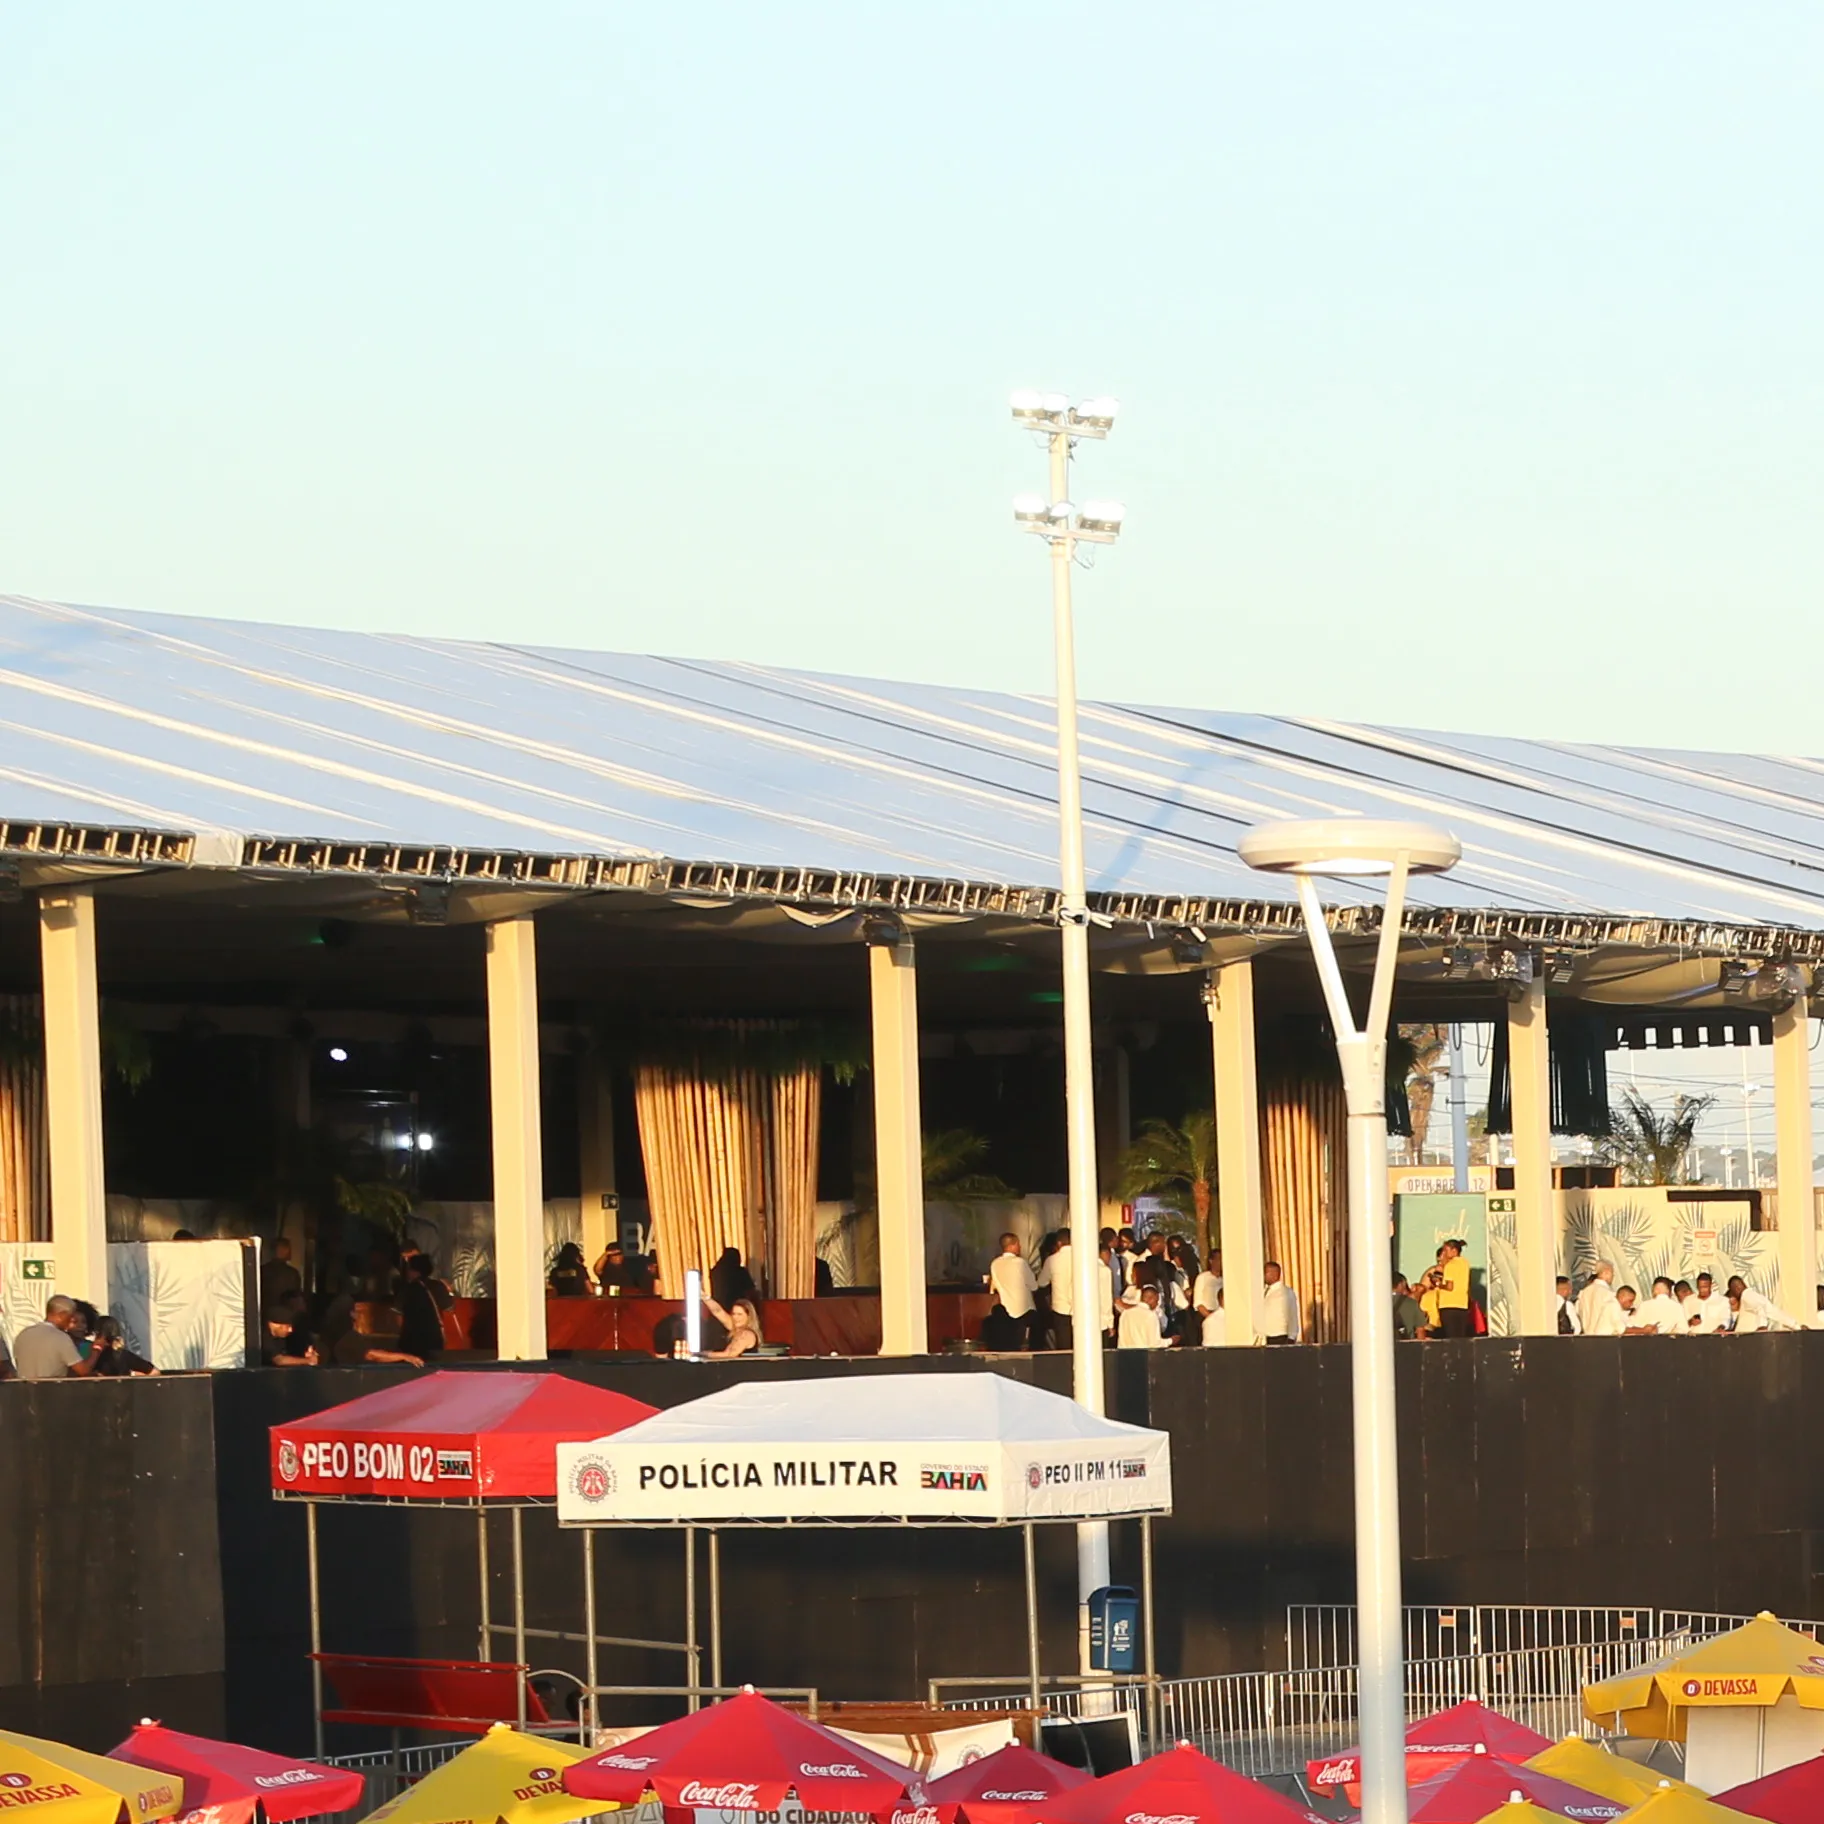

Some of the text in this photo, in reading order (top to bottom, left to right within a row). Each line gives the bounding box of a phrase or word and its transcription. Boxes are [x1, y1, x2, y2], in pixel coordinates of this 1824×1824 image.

[303, 1442, 435, 1483] PEO BOM 02
[1045, 1466, 1070, 1485] PEO
[1087, 1462, 1105, 1481] PM
[1108, 1460, 1122, 1479] 11
[639, 1459, 898, 1490] POLÍCIA MILITAR
[921, 1471, 988, 1491] BAHIA
[1704, 1679, 1758, 1697] DEVASSA
[255, 1768, 320, 1788] Coca-Cola
[800, 1762, 860, 1778] Coca-Cola
[680, 1781, 757, 1808] Coca-Cola
[981, 1789, 1044, 1802] Coca-Cola
[755, 1809, 780, 1824] DO
